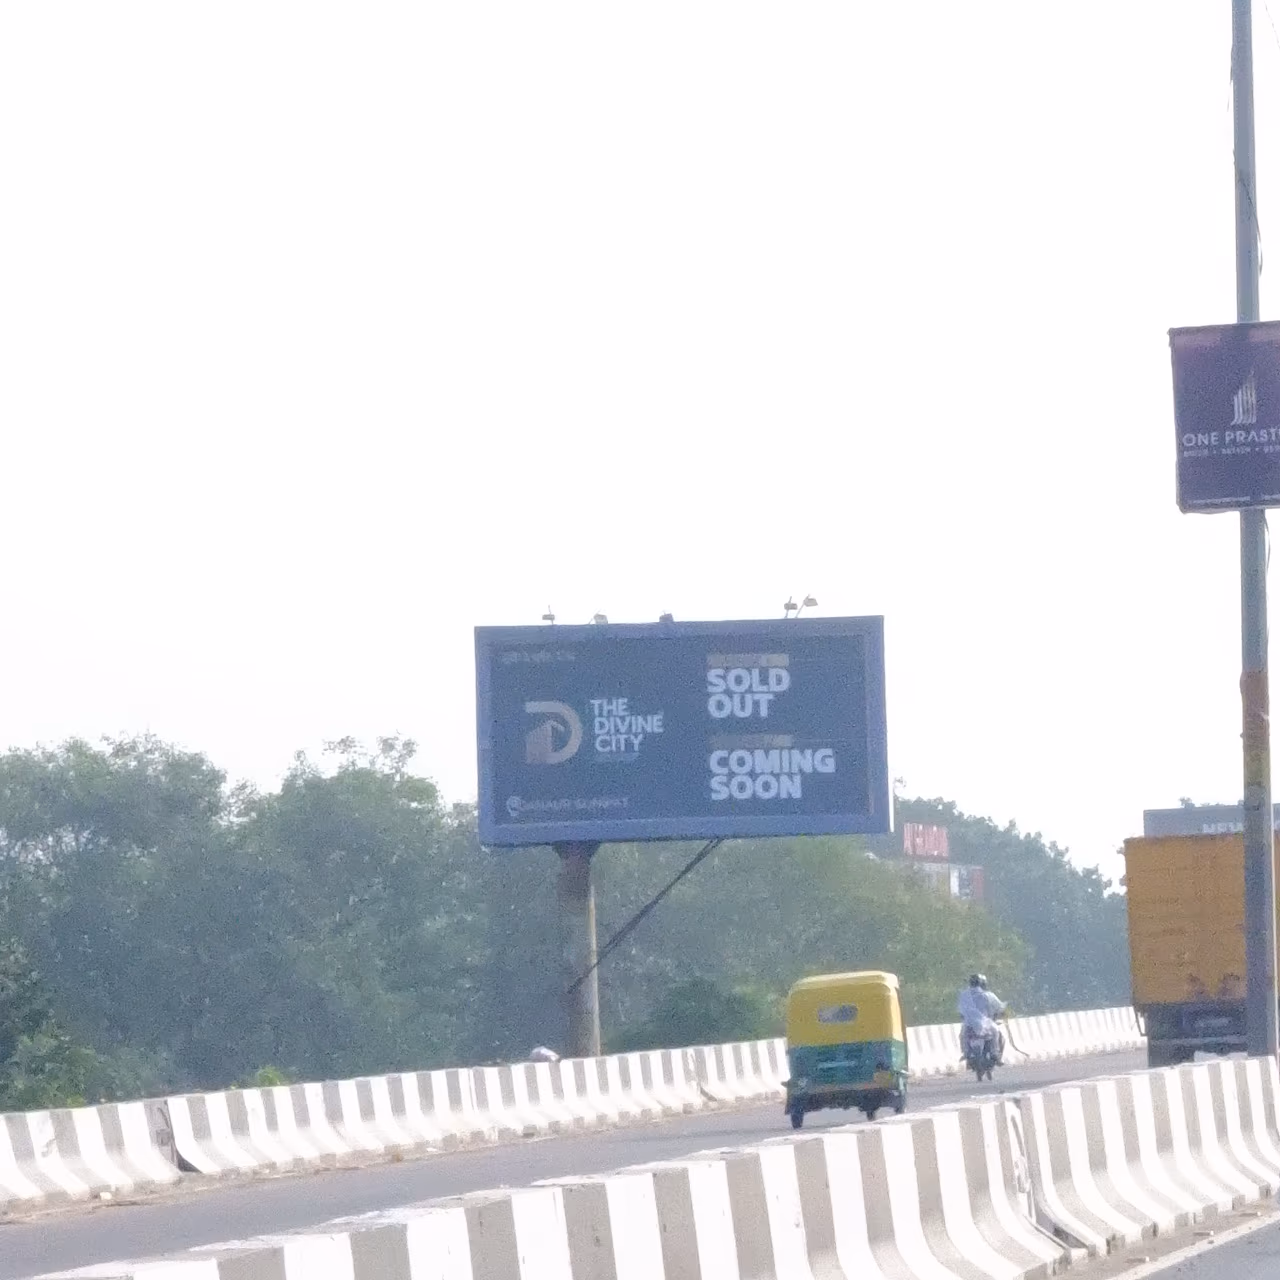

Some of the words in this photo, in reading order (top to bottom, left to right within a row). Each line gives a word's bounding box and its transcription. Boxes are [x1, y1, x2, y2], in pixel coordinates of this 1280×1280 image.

[1183, 432, 1219, 447] ONE
[707, 667, 791, 693] SOLD
[590, 697, 629, 716] THE
[708, 693, 774, 719] OUT
[594, 712, 664, 735] DIVINE
[595, 733, 642, 753] CITY
[709, 748, 836, 775] COMING
[710, 774, 801, 801] SOON
